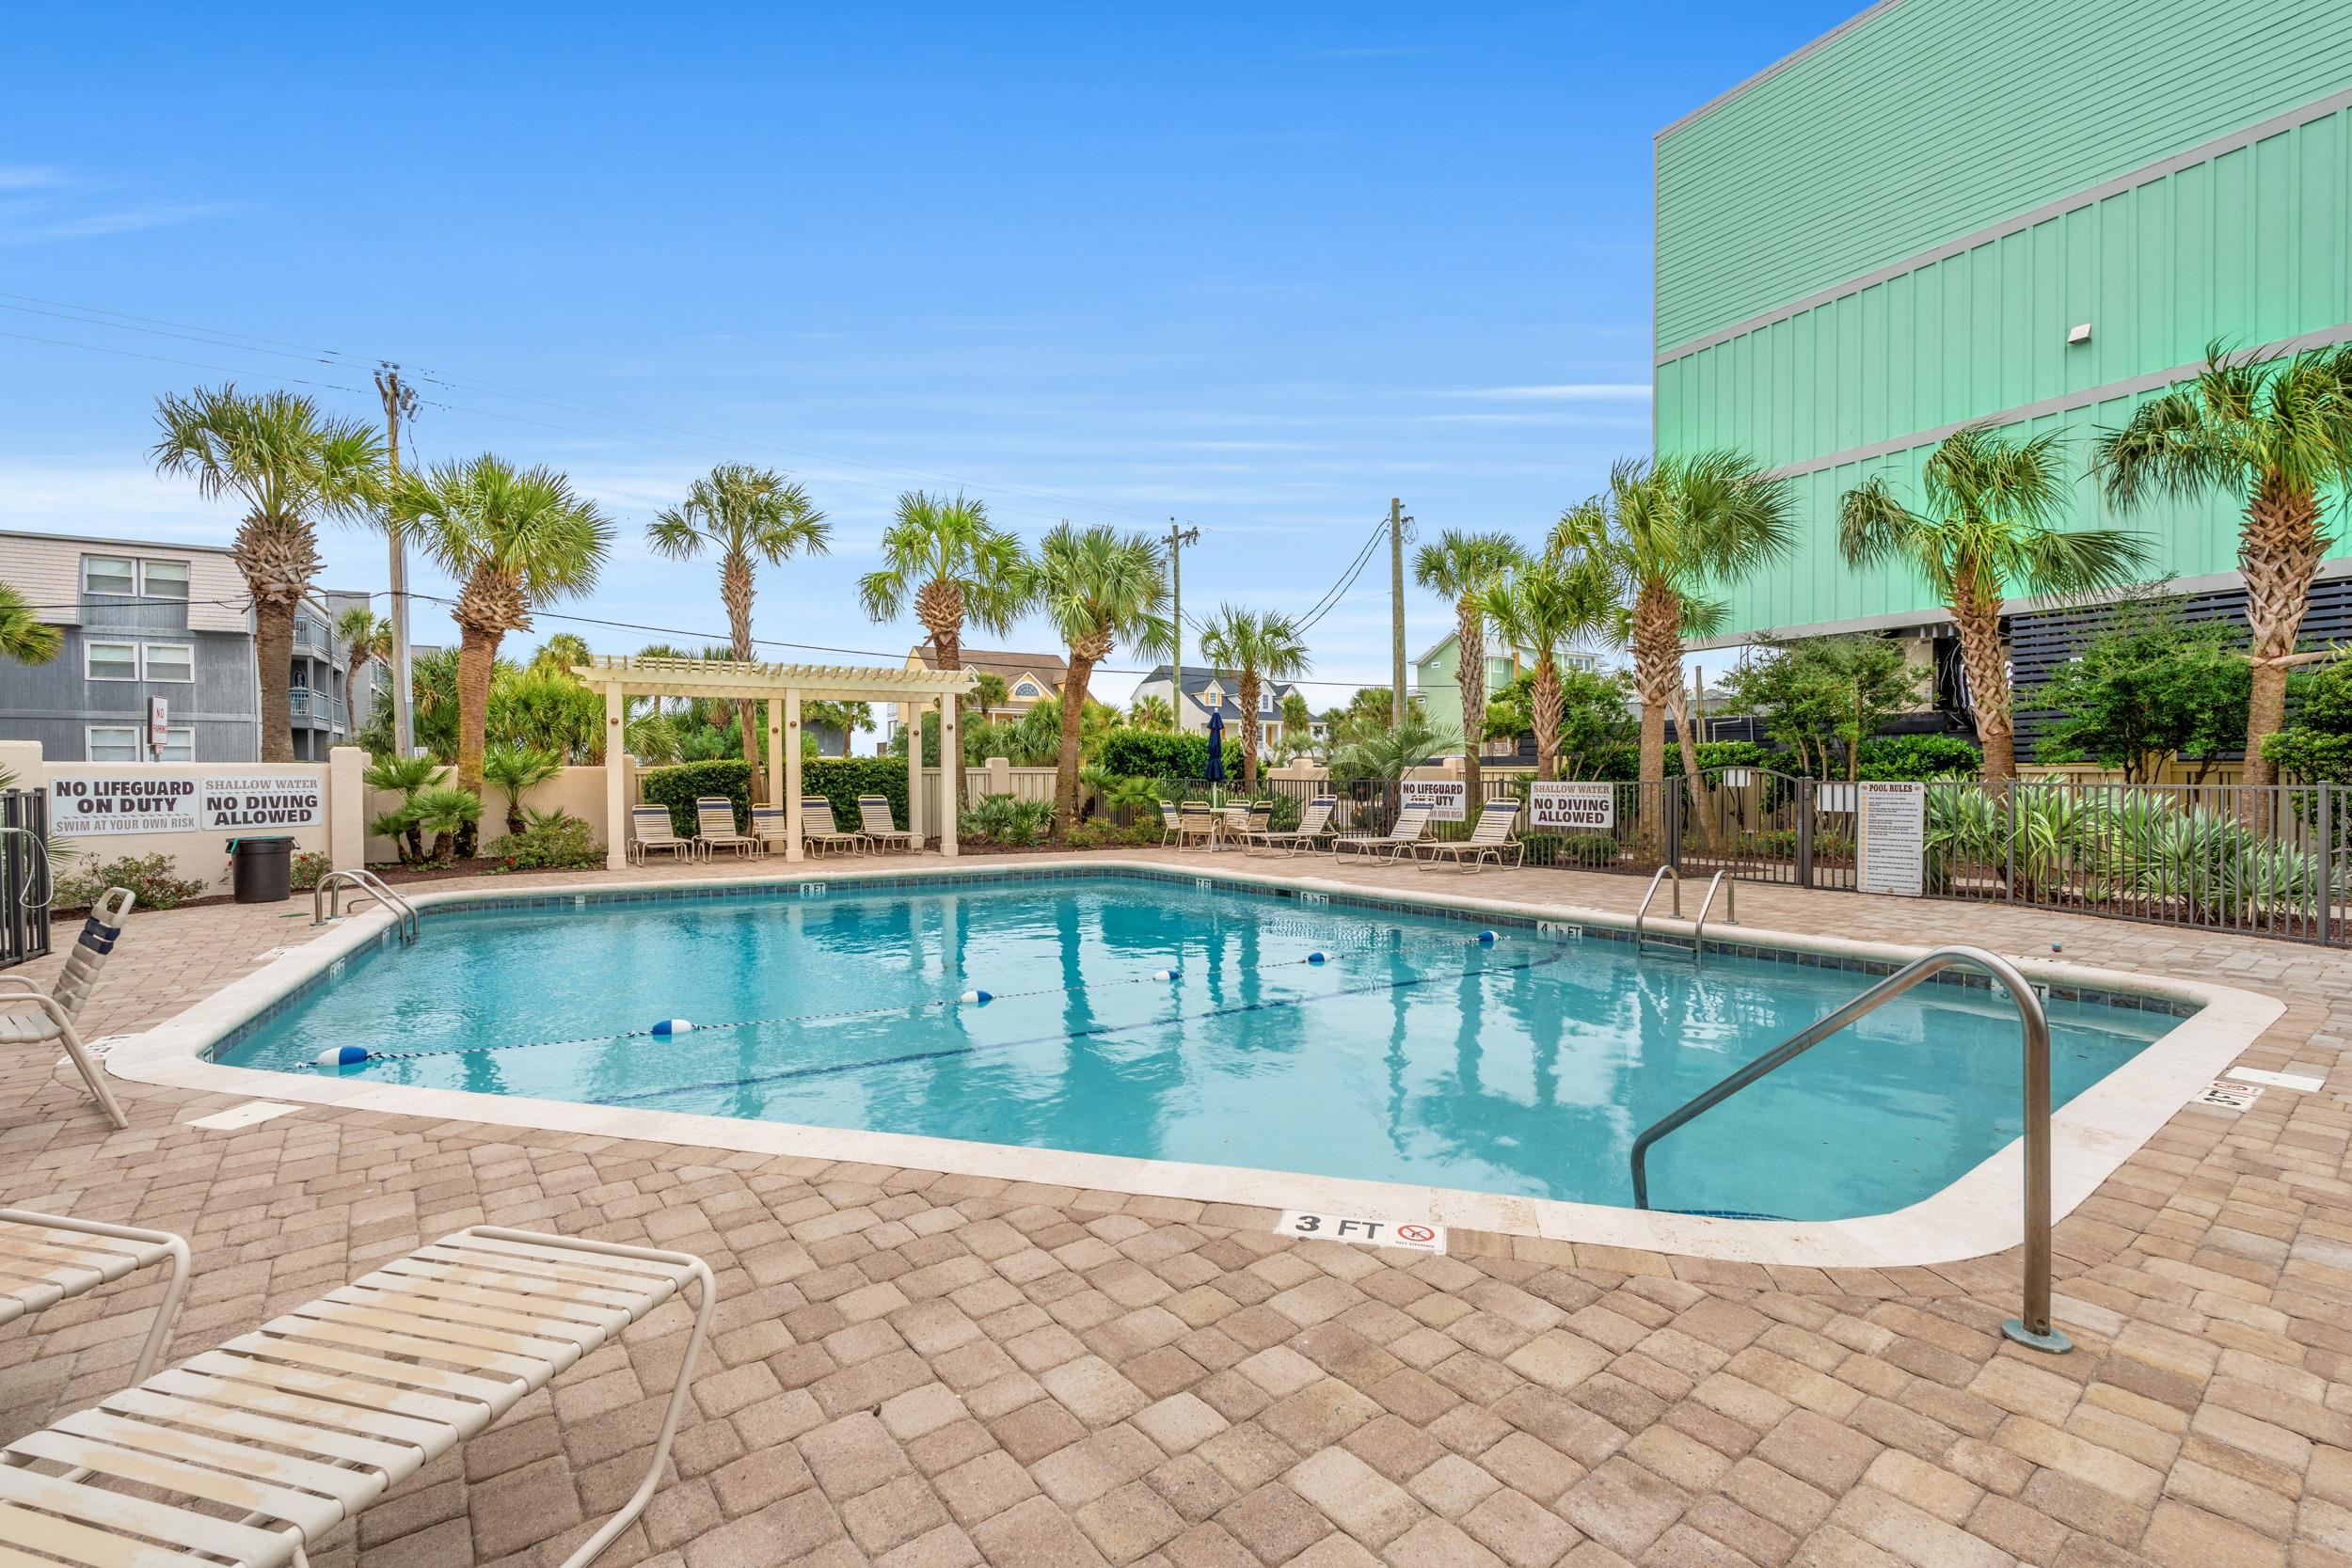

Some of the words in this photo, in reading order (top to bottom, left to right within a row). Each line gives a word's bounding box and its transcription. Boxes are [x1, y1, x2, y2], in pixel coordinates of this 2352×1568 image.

[156, 707, 164, 719] NO
[56, 782, 87, 797] NO
[94, 782, 195, 797] LIFEGUARD
[206, 780, 272, 790] SHALLOW
[275, 780, 318, 789] WATER
[1403, 784, 1415, 794] NO
[1417, 784, 1463, 795] LIFEGUARD
[1534, 784, 1576, 794] SHALLOW
[1578, 785, 1610, 794] WATER
[1889, 784, 1913, 793] RULES
[77, 799, 113, 814] ON
[119, 798, 178, 813] DUTY
[207, 797, 238, 811] NO
[246, 795, 318, 810] DIVING
[1534, 798, 1553, 810] NO
[1558, 799, 1610, 811] DIVING
[214, 809, 312, 826] ALLOWED
[1538, 810, 1605, 824] ALLOWED
[56, 820, 90, 832] SWIM
[94, 820, 106, 831] AT
[110, 819, 139, 830] YOUR
[142, 818, 167, 829] OWN
[171, 817, 195, 829] RISK
[803, 884, 810, 893] 8
[814, 884, 824, 895] FT
[1567, 926, 1581, 937] FT
[1295, 1215, 1321, 1231] 3
[1337, 1219, 1385, 1240] FT
